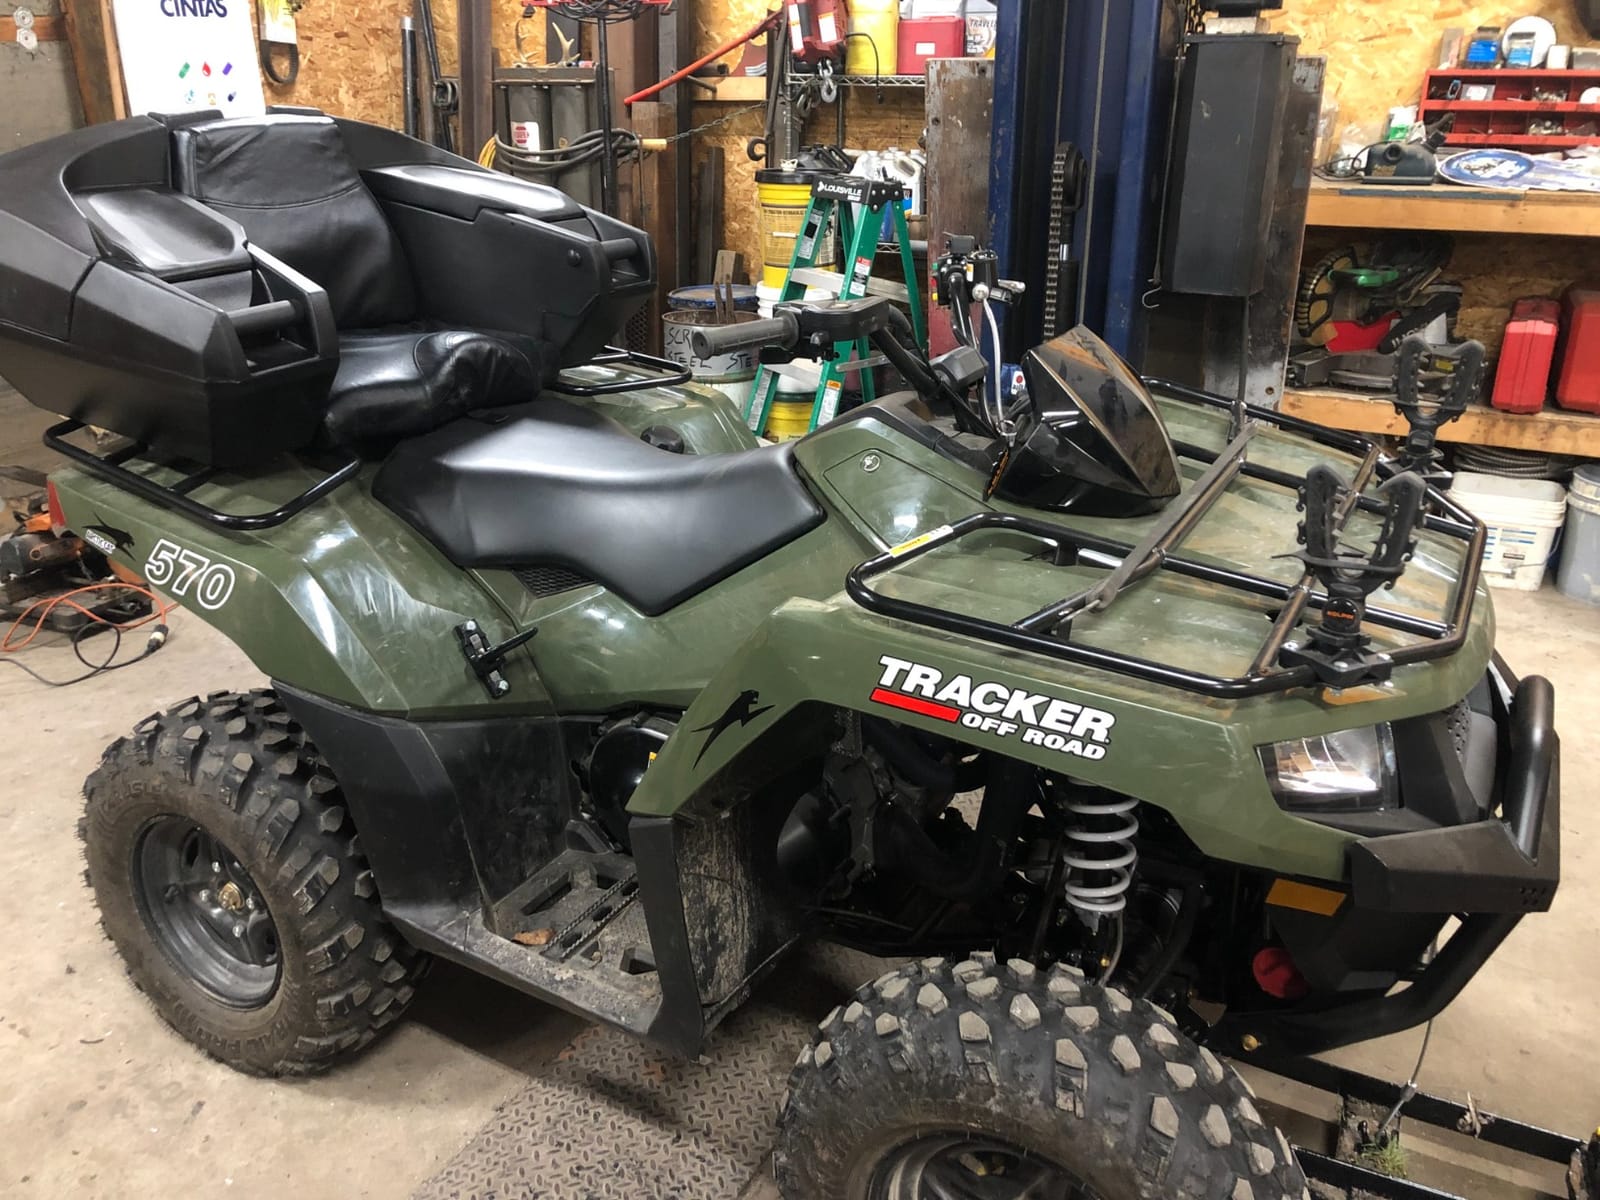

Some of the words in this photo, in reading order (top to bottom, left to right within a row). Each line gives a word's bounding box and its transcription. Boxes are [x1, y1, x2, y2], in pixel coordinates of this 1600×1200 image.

[160, 0, 228, 18] CINTAS
[824, 184, 862, 196] LOUISVILLE
[666, 326, 694, 350] SCR
[145, 538, 236, 610] 570
[878, 655, 1116, 744] TRACKER
[961, 712, 1019, 737] OFF
[1021, 727, 1107, 761] ROAD
